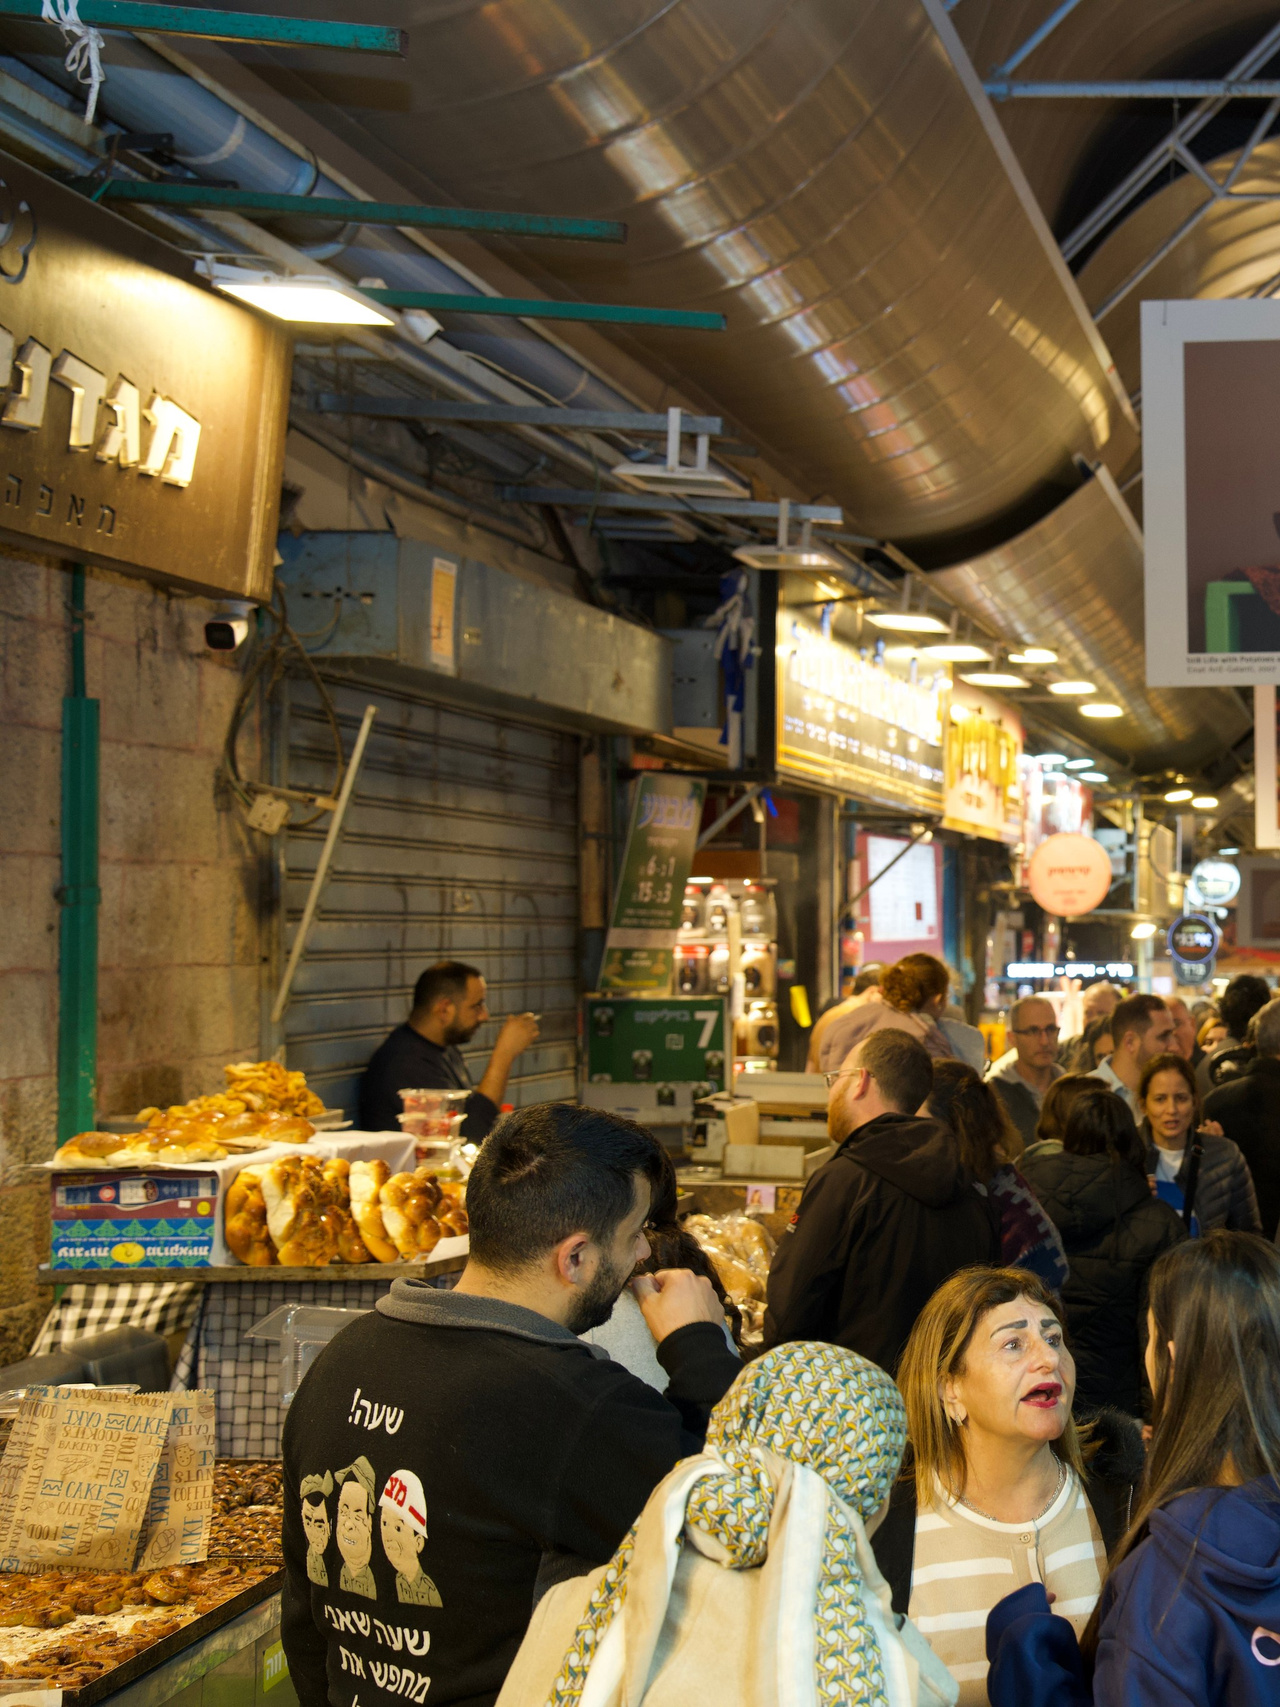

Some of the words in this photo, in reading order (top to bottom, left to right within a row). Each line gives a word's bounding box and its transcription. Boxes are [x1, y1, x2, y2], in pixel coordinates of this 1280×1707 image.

[694, 1010, 719, 1048] 7
[58, 1245, 110, 1258] עוגיות
[62, 1409, 102, 1428] CAKE
[125, 1414, 164, 1435] CAKE
[348, 1388, 404, 1435] שעה!
[58, 1440, 100, 1452] BAKERY
[62, 1425, 121, 1443] COOKIES
[176, 1424, 209, 1437] CAFE
[20, 1446, 49, 1513] PASTRIES
[65, 1481, 107, 1501] CAKE
[384, 1476, 407, 1508] מצ
[57, 1501, 89, 1517] CAFE
[98, 1492, 124, 1535] CAKE
[27, 1523, 60, 1541] FOOD
[56, 1521, 80, 1556] CAKE
[77, 1504, 101, 1557] BAKERY
[180, 1516, 203, 1557] CAKE
[324, 1604, 370, 1638] שאני
[373, 1618, 431, 1657] שעה
[339, 1645, 367, 1680] את
[369, 1660, 431, 1704] מחפש
